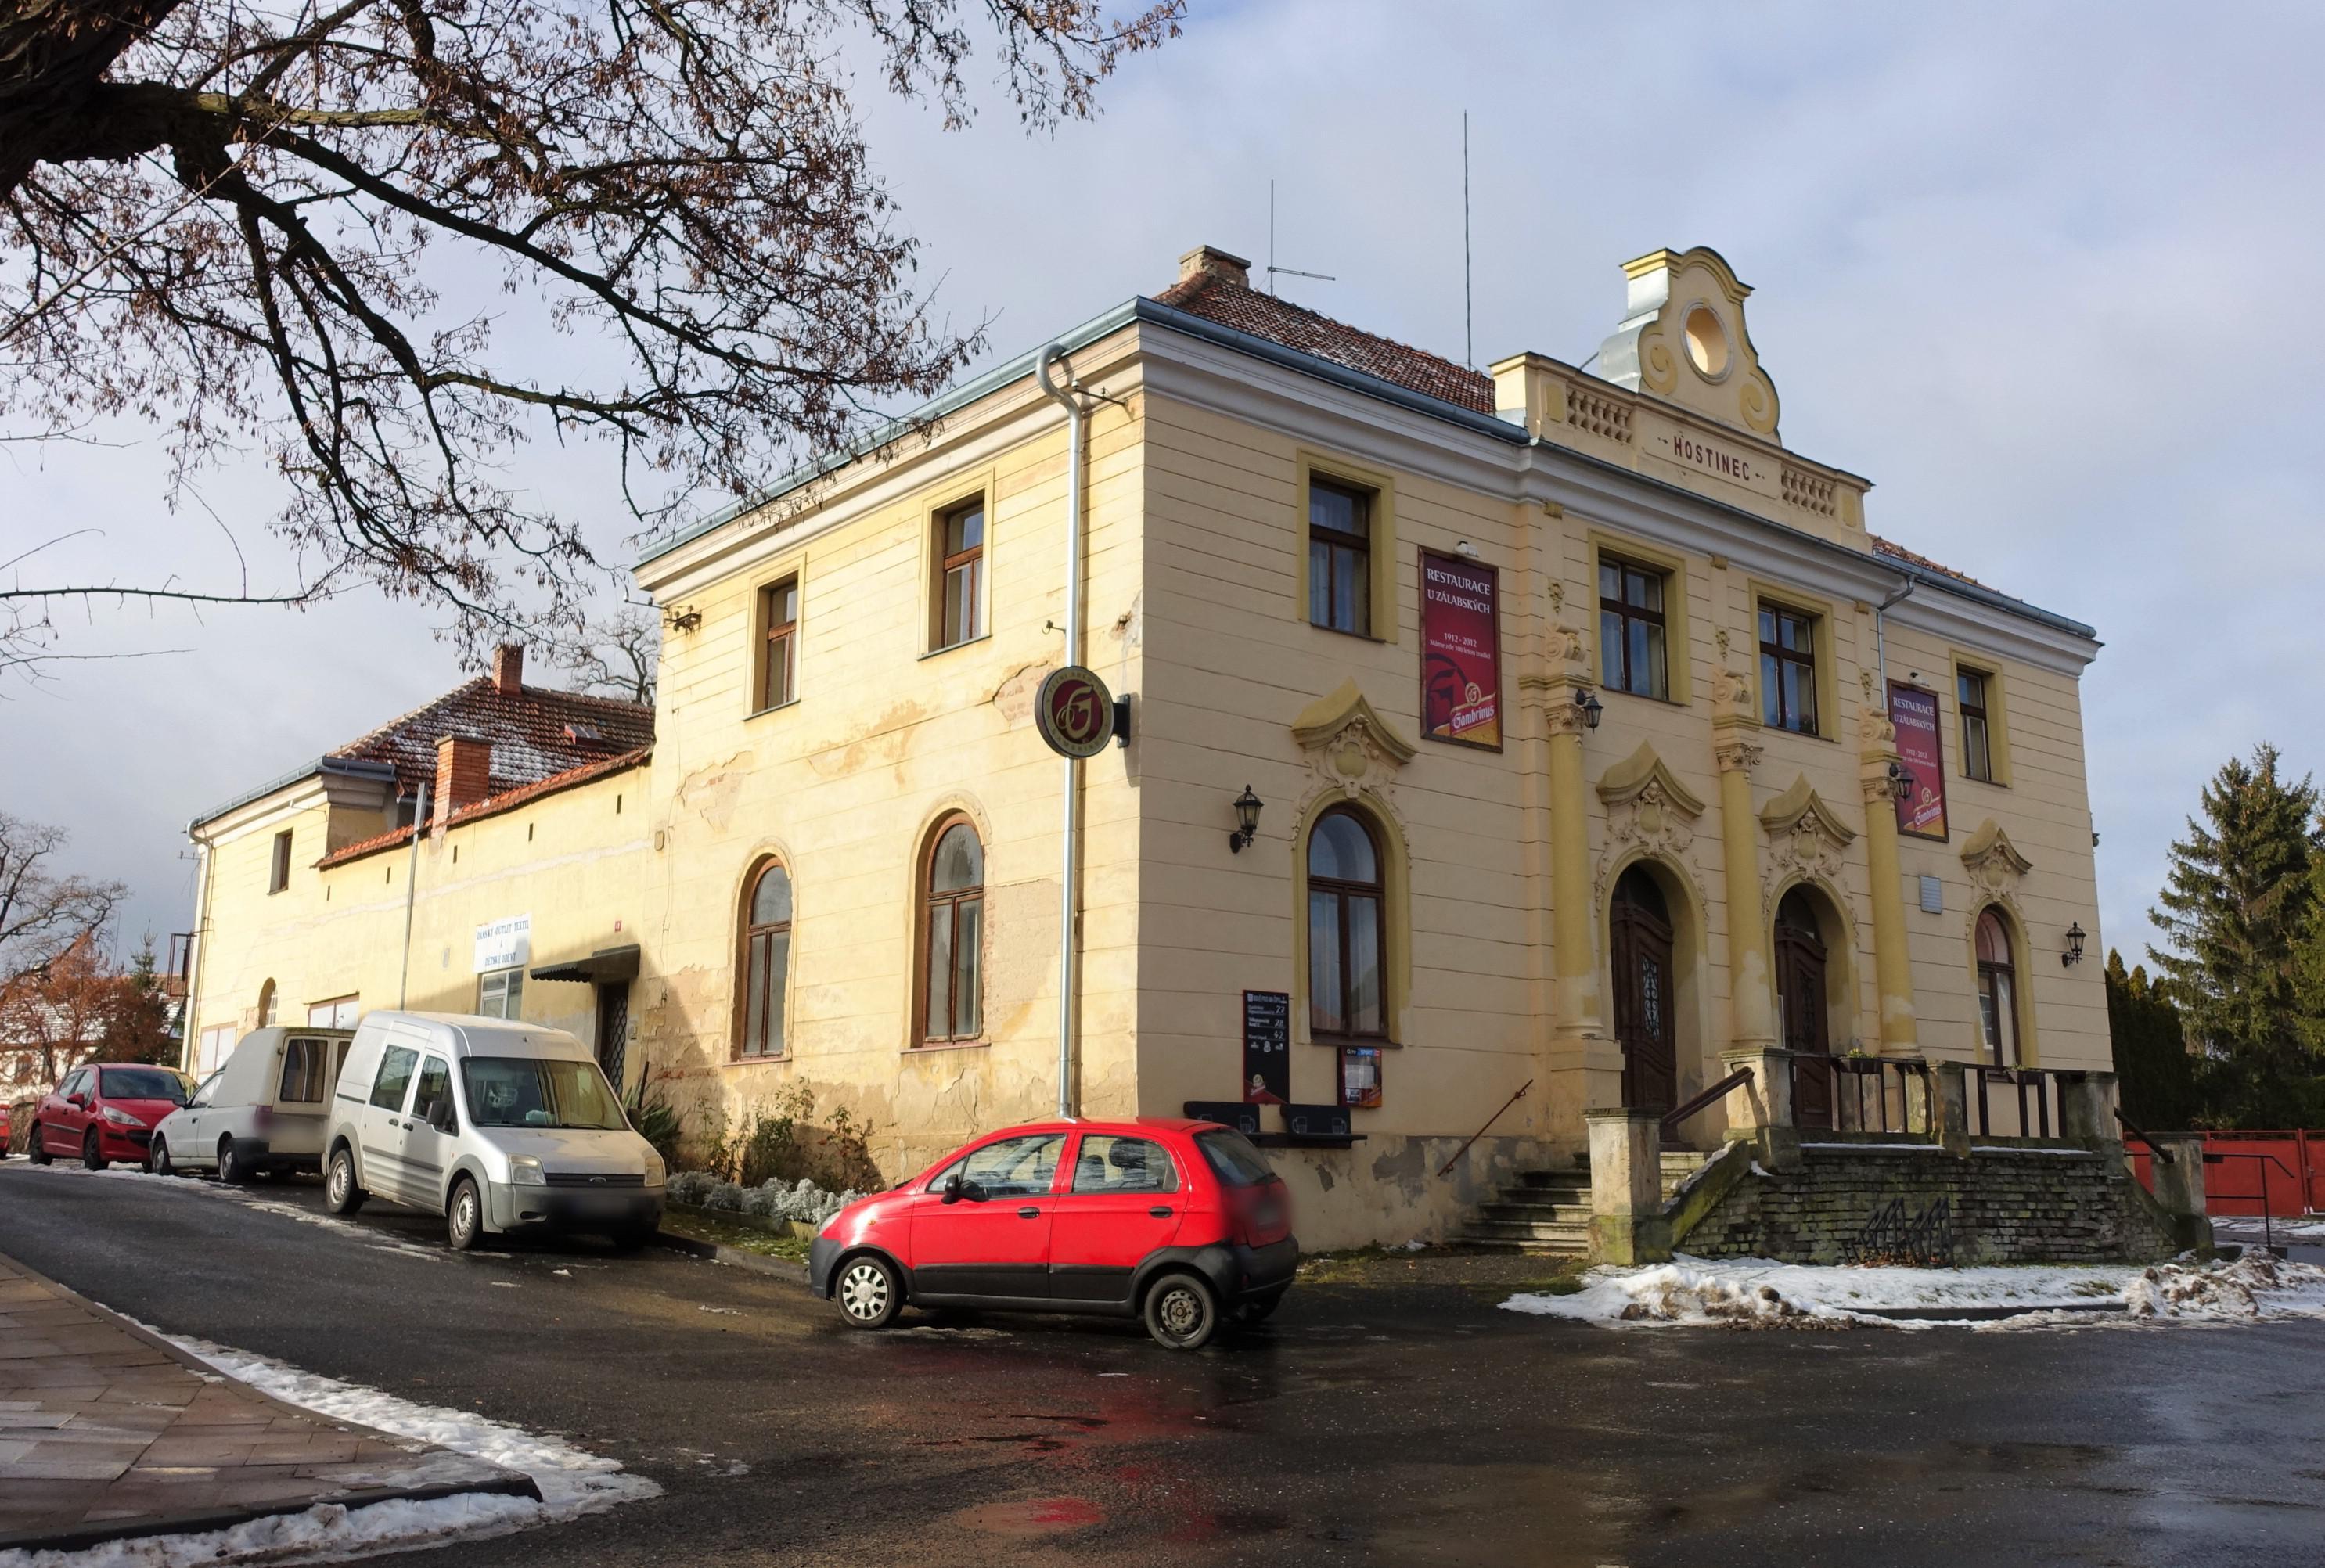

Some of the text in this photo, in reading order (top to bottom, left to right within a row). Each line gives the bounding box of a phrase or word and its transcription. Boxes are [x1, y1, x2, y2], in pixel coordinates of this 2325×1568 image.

[1674, 436, 1750, 481] HOSTINEC
[1427, 568, 1490, 595] RESTAURACE
[1427, 588, 1490, 614] U ZÁLABSKÝCH
[1444, 632, 1459, 643] 1912
[1463, 637, 1477, 648] 2012
[1451, 704, 1495, 729] Gambrinus
[1893, 696, 1934, 717] RESTAURACE
[1894, 713, 1899, 722] U
